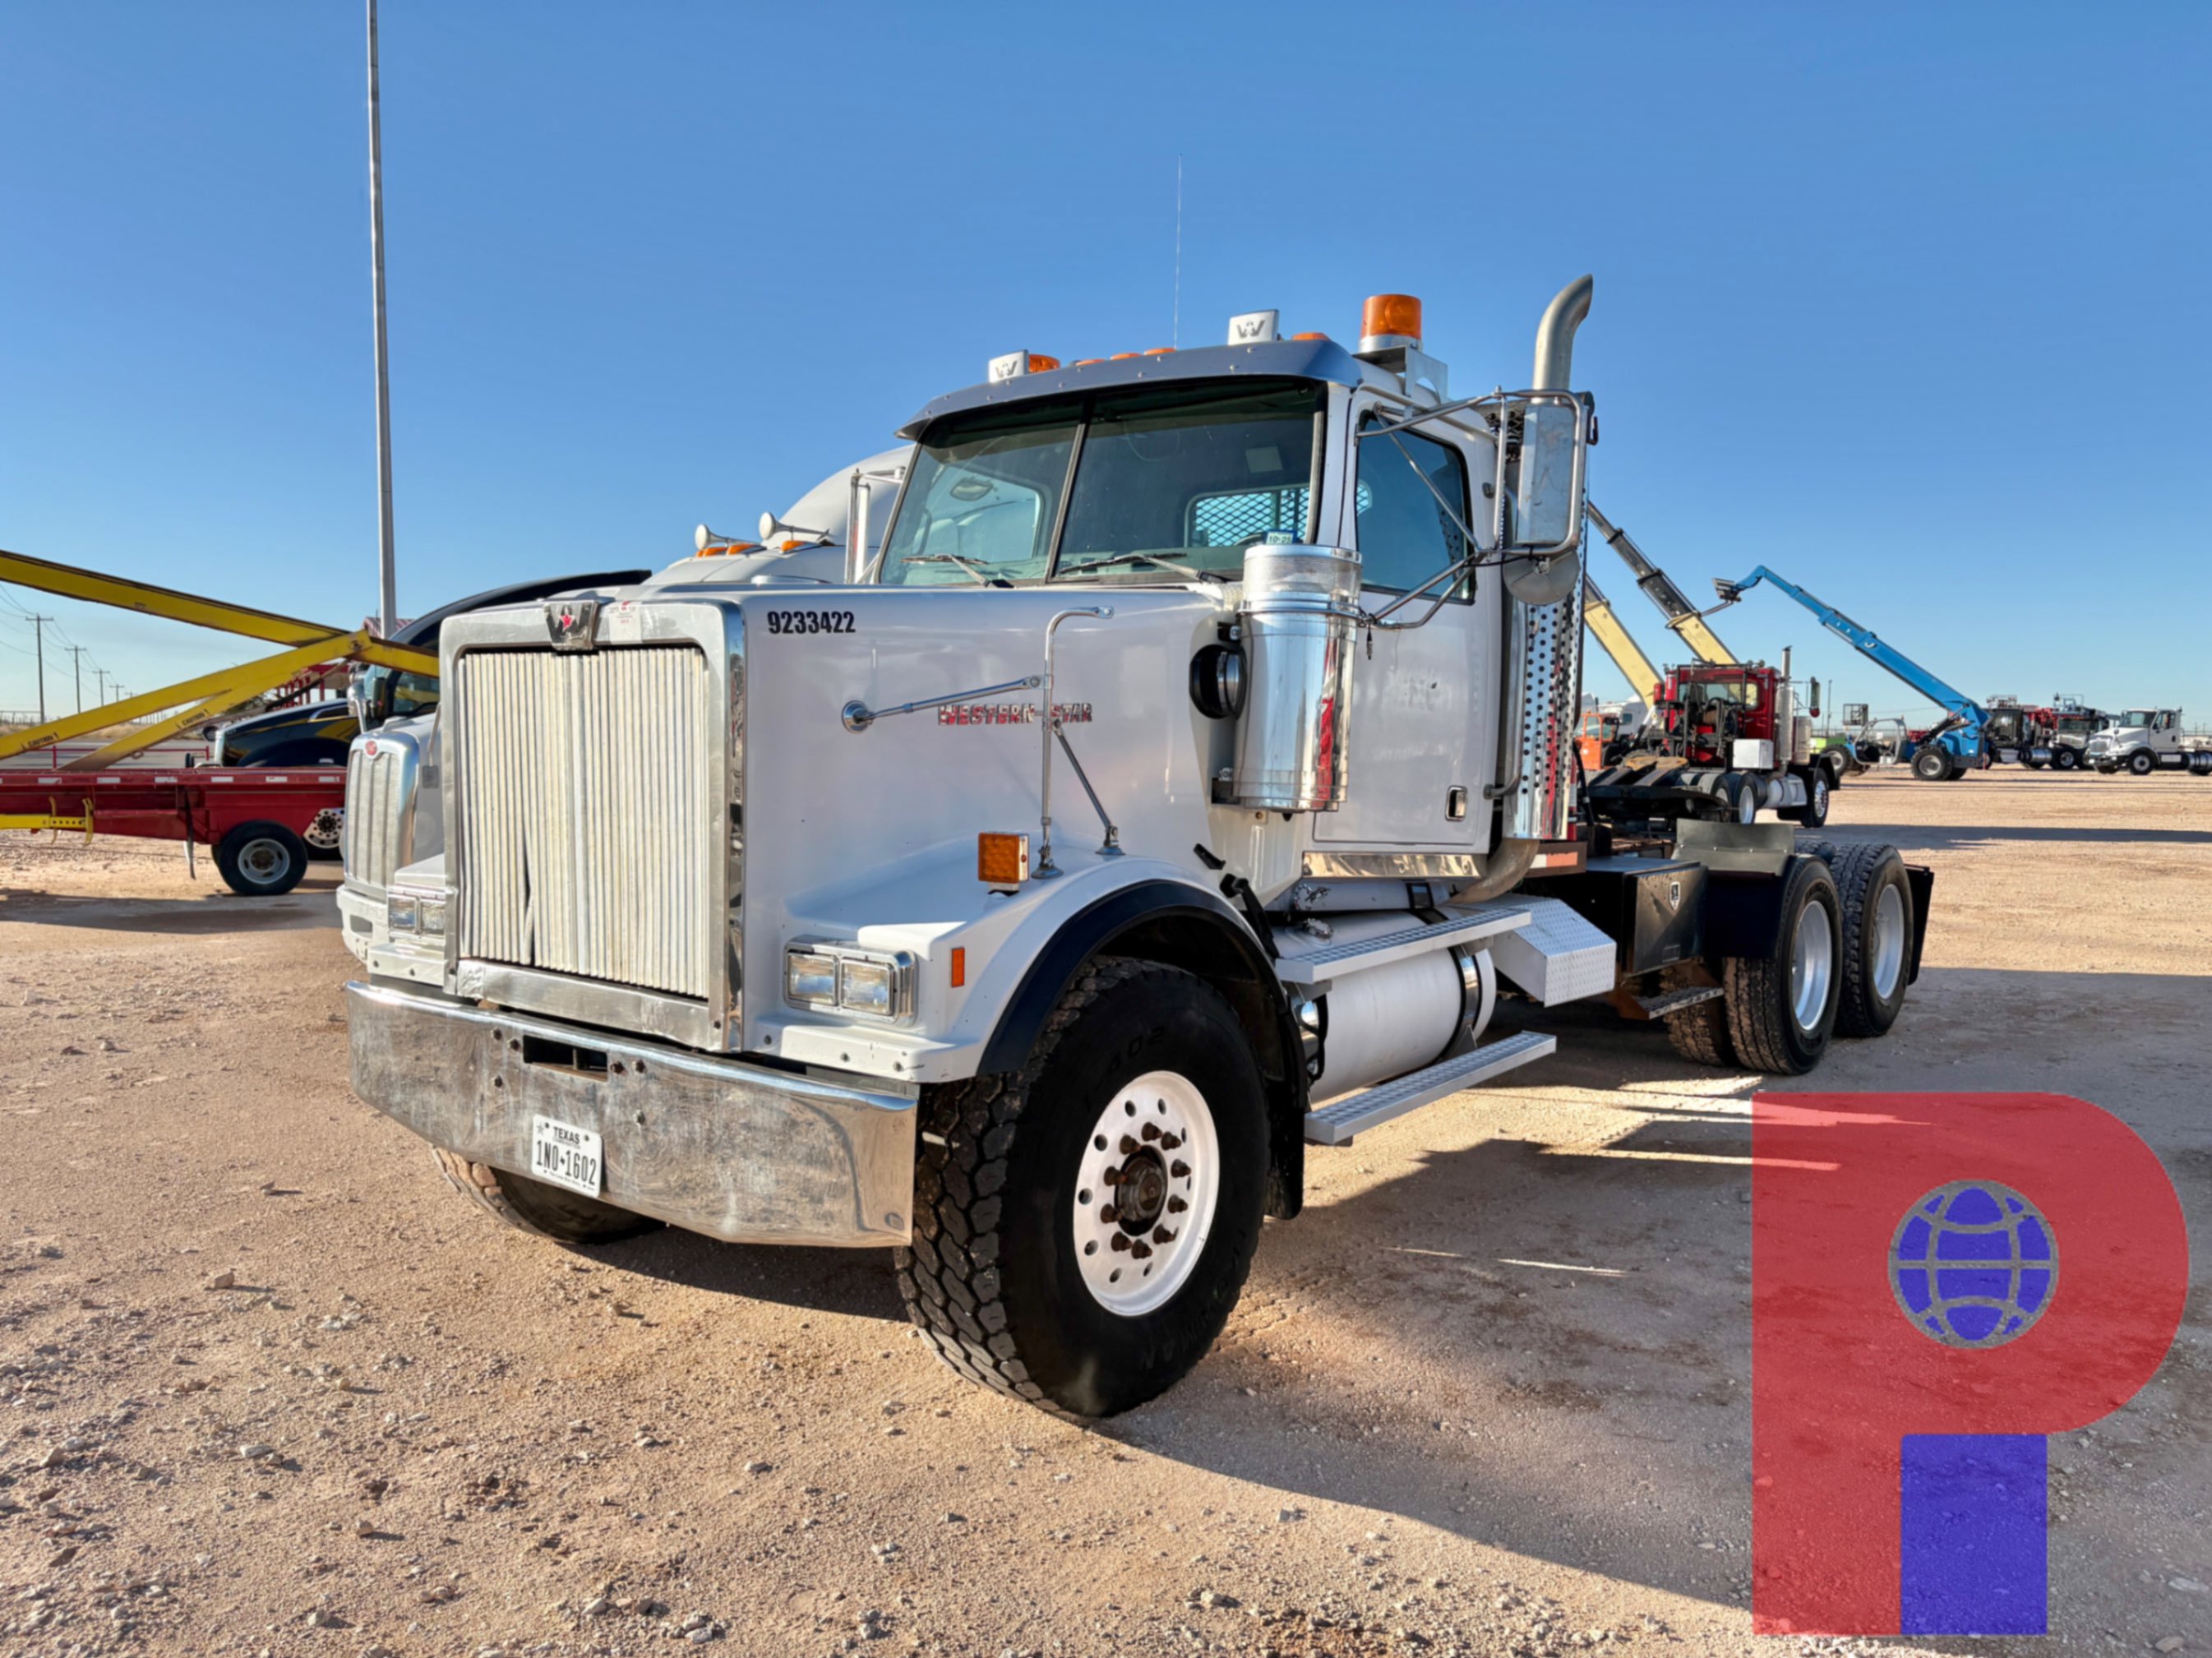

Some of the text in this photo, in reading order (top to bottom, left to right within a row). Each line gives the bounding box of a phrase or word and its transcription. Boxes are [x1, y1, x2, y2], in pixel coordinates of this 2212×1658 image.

[767, 611, 856, 634] 9233422
[938, 703, 1092, 726] WESTERN STAR
[553, 1126, 580, 1145] TEXAS
